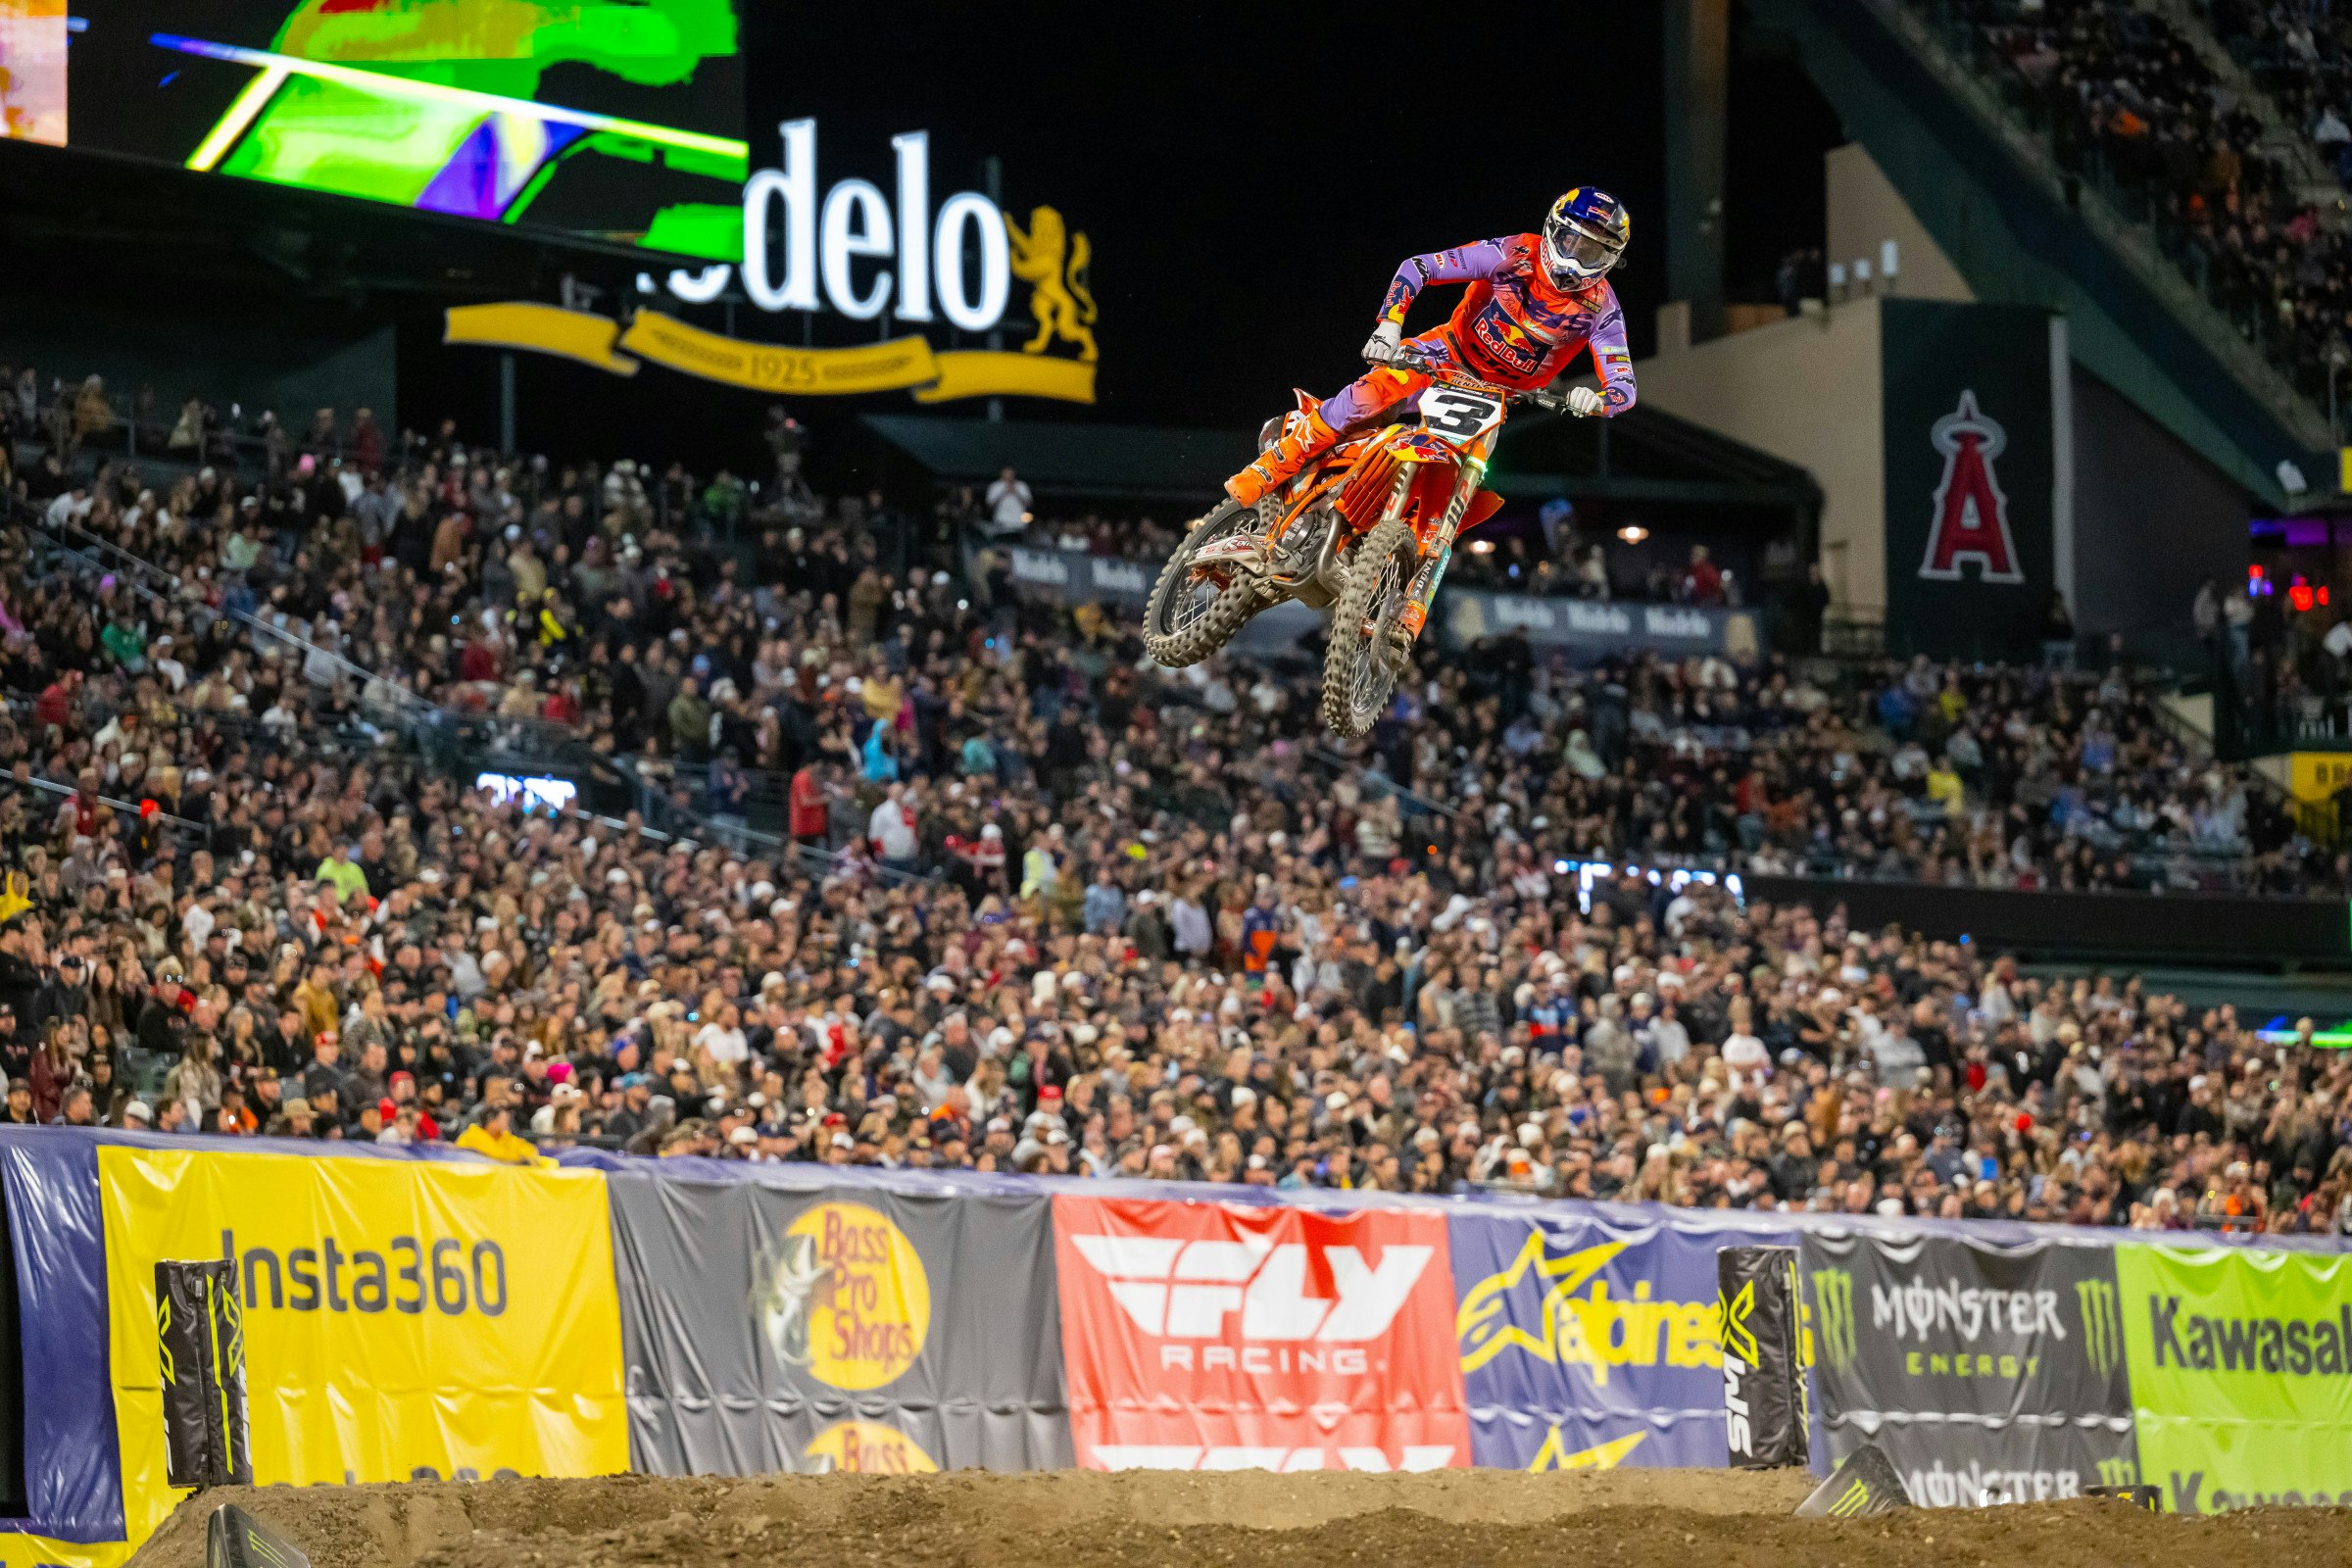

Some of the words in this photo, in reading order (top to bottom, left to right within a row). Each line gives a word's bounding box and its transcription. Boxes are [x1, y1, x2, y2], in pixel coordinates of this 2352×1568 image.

[635, 117, 1010, 331] delo
[750, 353, 818, 385] 1925
[1474, 317, 1506, 356] Red
[1500, 350, 1538, 372] Bull
[1423, 394, 1496, 436] 3
[1416, 558, 1437, 590] DUN
[822, 1208, 890, 1266] Bass
[831, 1260, 878, 1311] Pro
[1071, 1234, 1434, 1341] FLY
[1871, 1276, 2067, 1343] MONSTER
[830, 1315, 914, 1376] Shops
[1160, 1346, 1368, 1375] RACING
[1906, 1351, 2040, 1377] ENERGY
